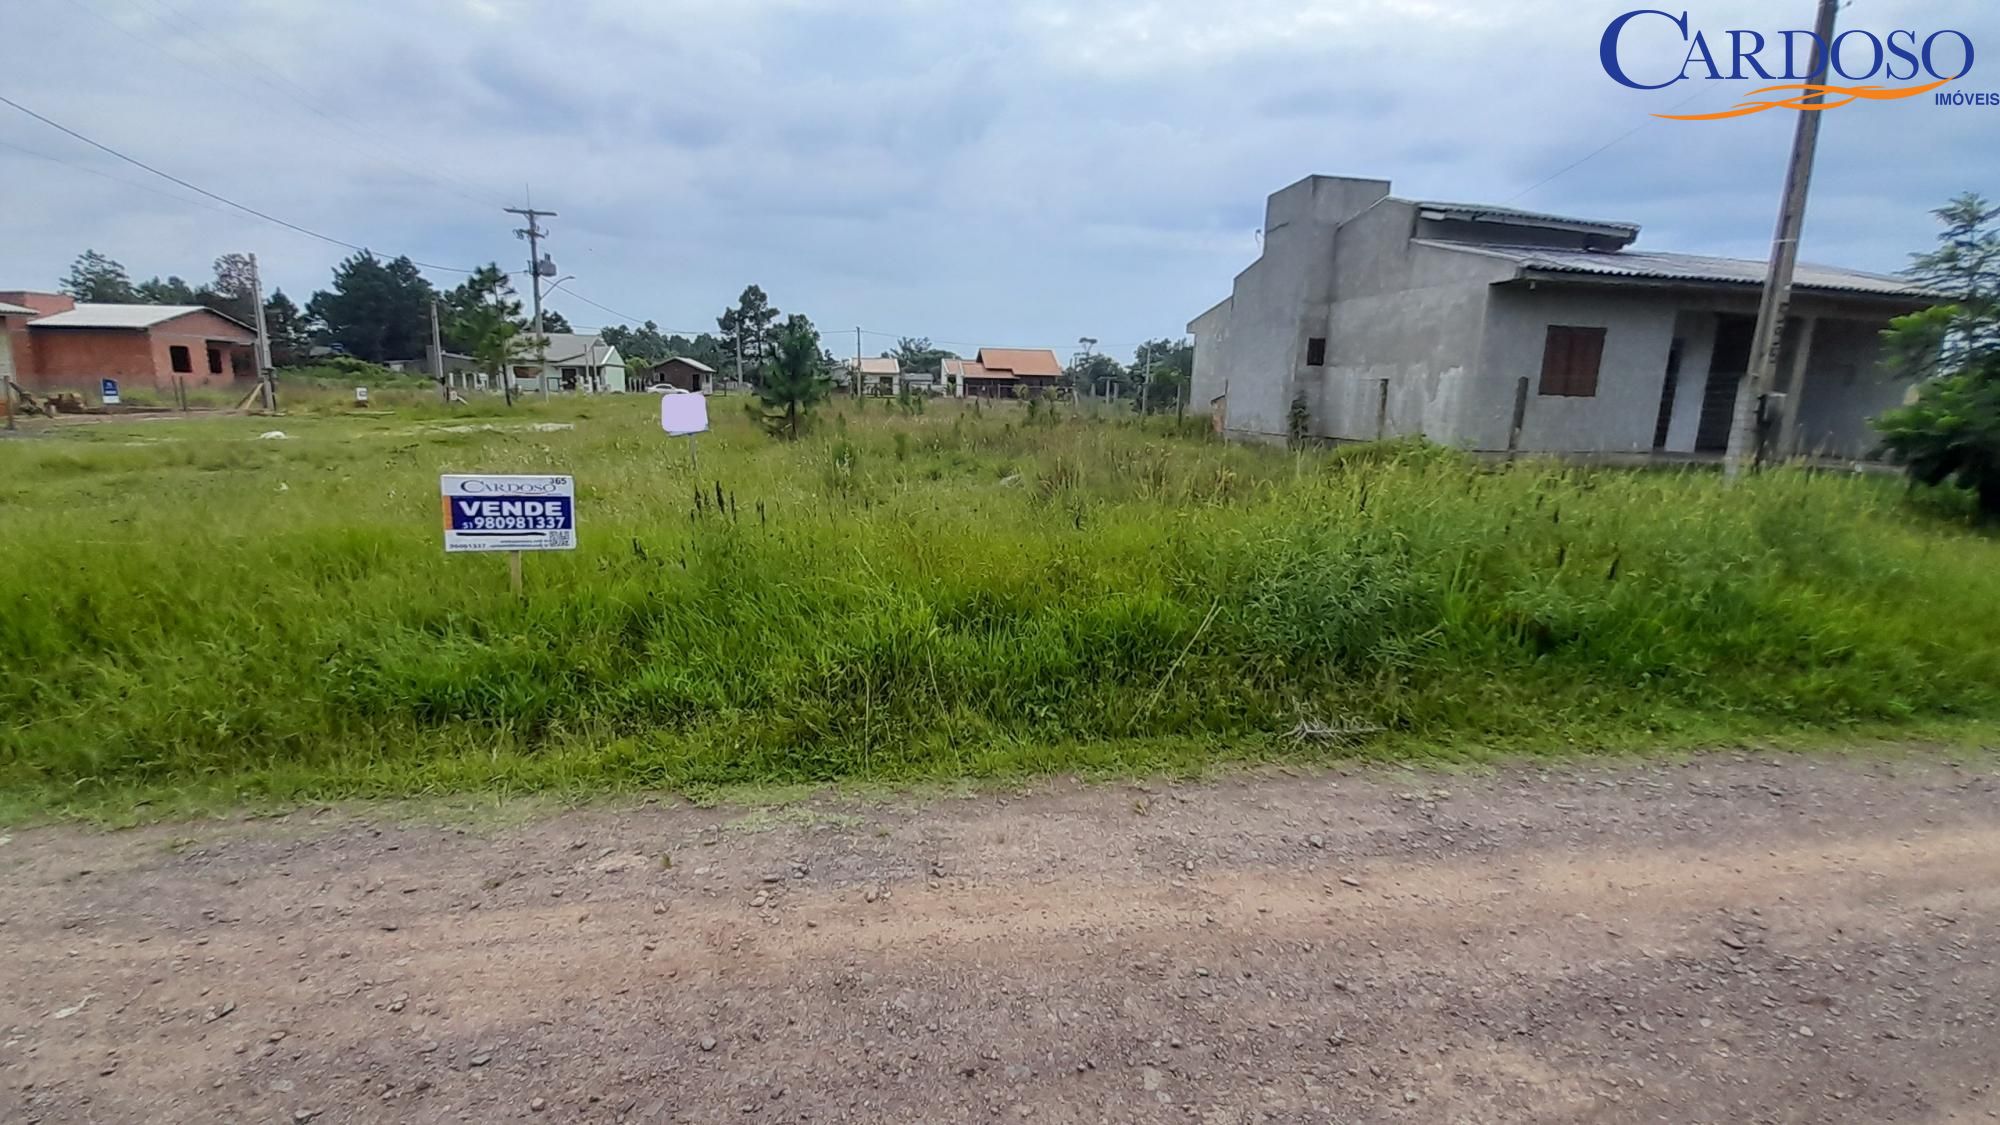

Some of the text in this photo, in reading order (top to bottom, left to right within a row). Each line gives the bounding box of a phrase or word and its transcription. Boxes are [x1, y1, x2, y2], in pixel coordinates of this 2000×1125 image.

[460, 480, 557, 493] CARDOSO
[458, 501, 563, 516] VENDE
[474, 516, 565, 529] 980981337
